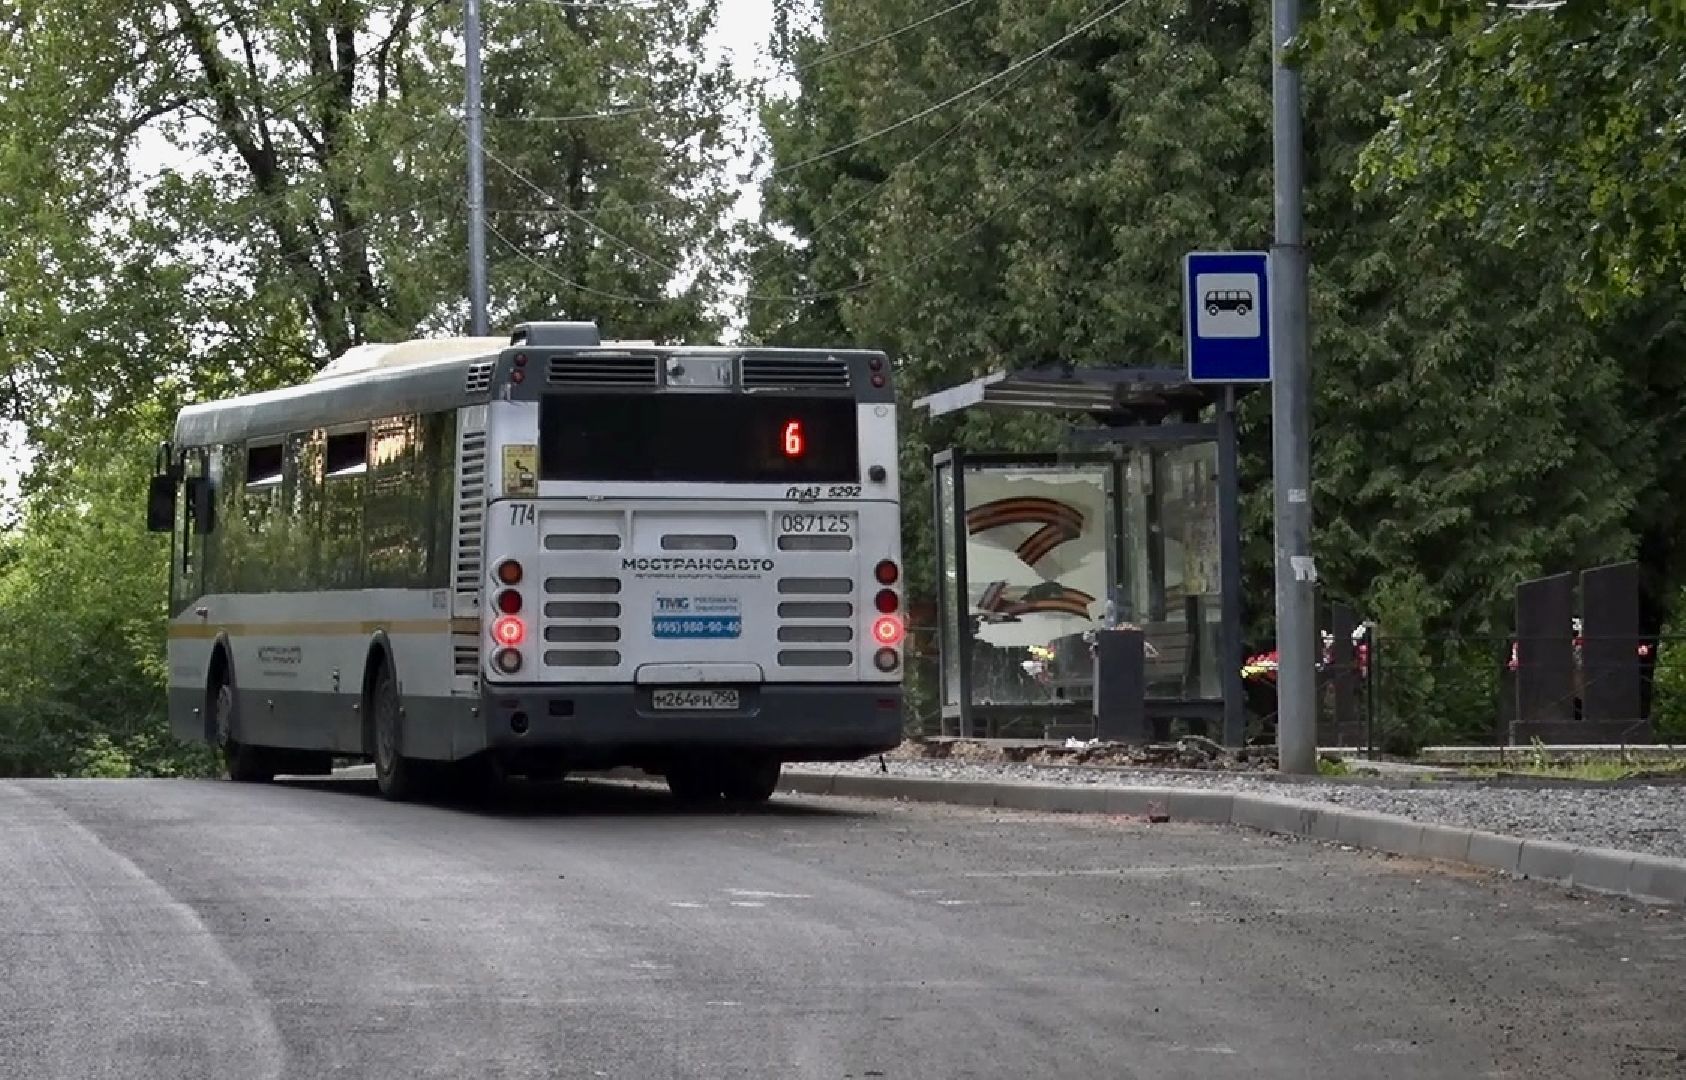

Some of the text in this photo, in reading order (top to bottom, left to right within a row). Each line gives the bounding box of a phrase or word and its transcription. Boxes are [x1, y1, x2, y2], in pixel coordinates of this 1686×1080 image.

[785, 422, 800, 454] 6
[828, 486, 862, 497] 5292
[510, 504, 534, 526] 774
[782, 513, 849, 532] 087125
[621, 558, 775, 571] МОСТРАНСАВТО
